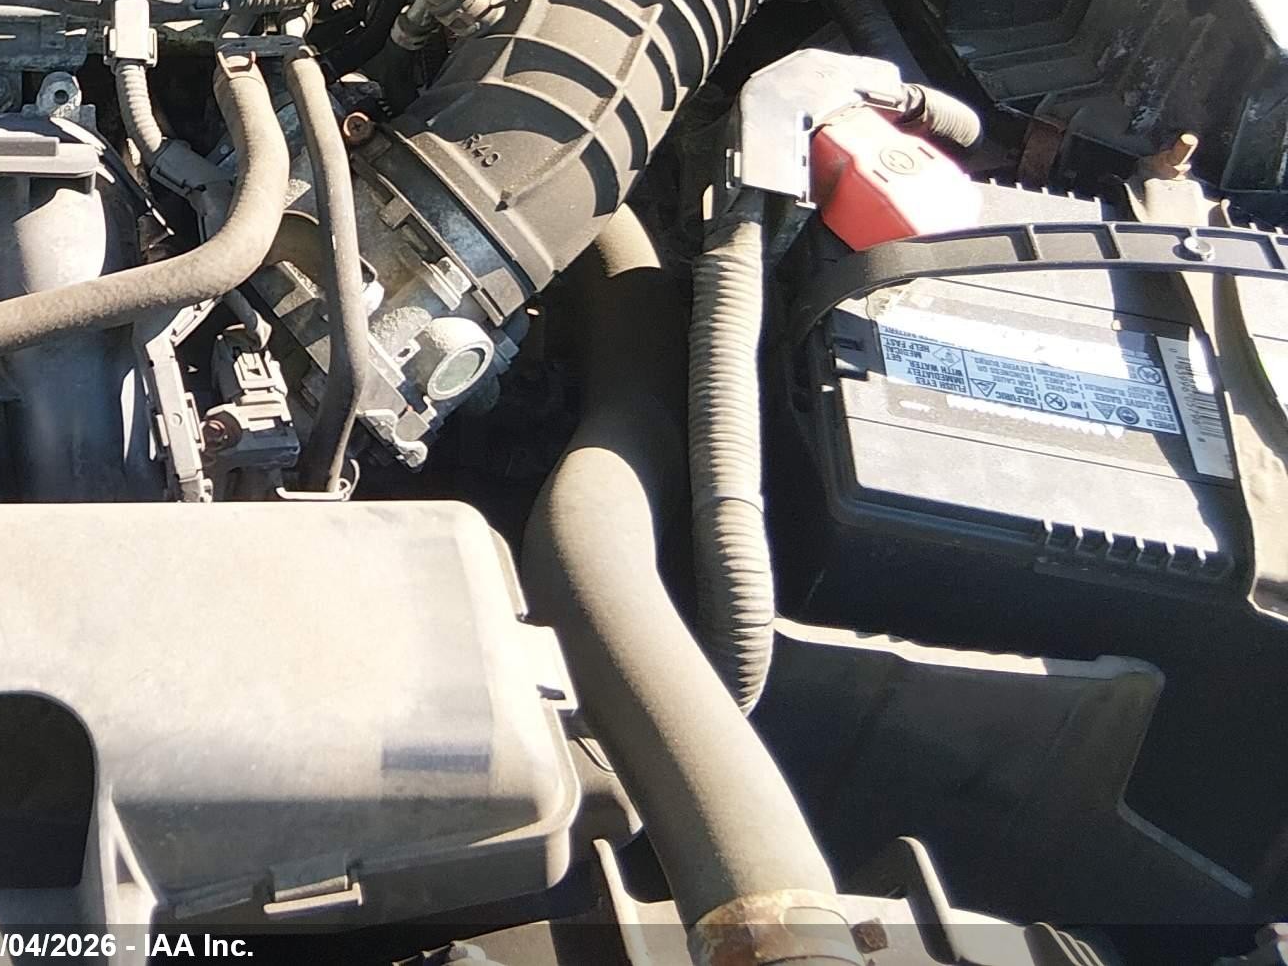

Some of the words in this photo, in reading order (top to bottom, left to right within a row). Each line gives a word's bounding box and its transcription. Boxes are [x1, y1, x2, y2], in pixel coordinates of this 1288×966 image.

[883, 344, 921, 358] MEDICAL
[907, 341, 930, 352] HELP
[884, 352, 902, 362] GET
[906, 359, 938, 371] WATER.
[940, 365, 962, 376] WITH
[906, 367, 964, 384] IMMEDIATELY
[914, 376, 937, 387] EYES
[938, 381, 966, 392] FLUSH
[1014, 386, 1034, 396] ACID
